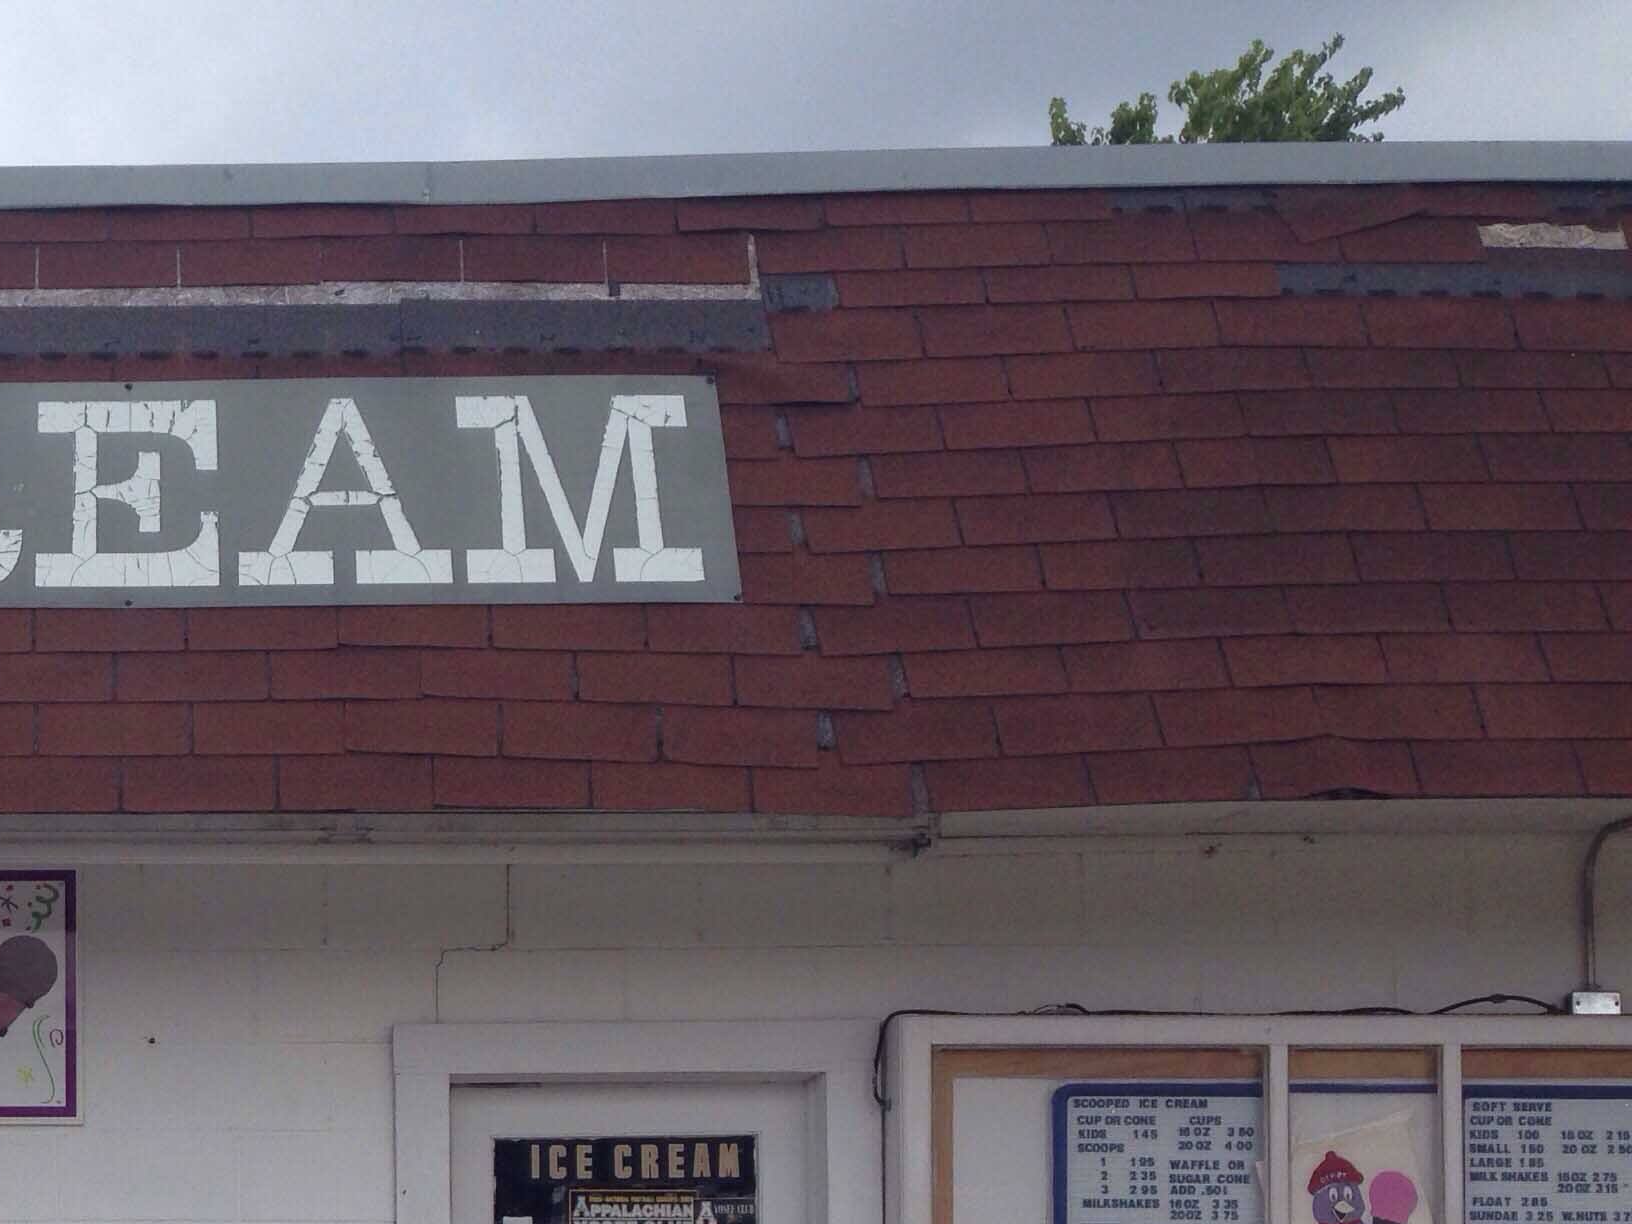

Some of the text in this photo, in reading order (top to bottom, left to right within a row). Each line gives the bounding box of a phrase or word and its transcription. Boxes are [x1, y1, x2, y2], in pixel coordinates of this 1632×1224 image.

[1072, 1098, 1208, 1109] SCOOPED ICE CREAM
[1472, 1102, 1552, 1112] SOFT SERVE
[1077, 1116, 1156, 1125] CUP OR CONE
[1189, 1116, 1222, 1126] CUPS
[1470, 1116, 1494, 1126] CUP
[1518, 1116, 1552, 1126] CONE
[1078, 1129, 1107, 1139] KIDS
[1469, 1130, 1498, 1139] KIDS
[1078, 1144, 1124, 1153] SCOOPS
[1469, 1144, 1511, 1153] SMALL
[531, 1143, 740, 1180] ICE CREAM
[1169, 1160, 1245, 1170] WAFFLE OR
[1470, 1158, 1512, 1168] LARGE
[1169, 1174, 1250, 1184] SUGAR CONE
[1170, 1185, 1196, 1195] ADD
[573, 1195, 693, 1217] APPALACHIAN
[1472, 1197, 1511, 1207] FLOAT
